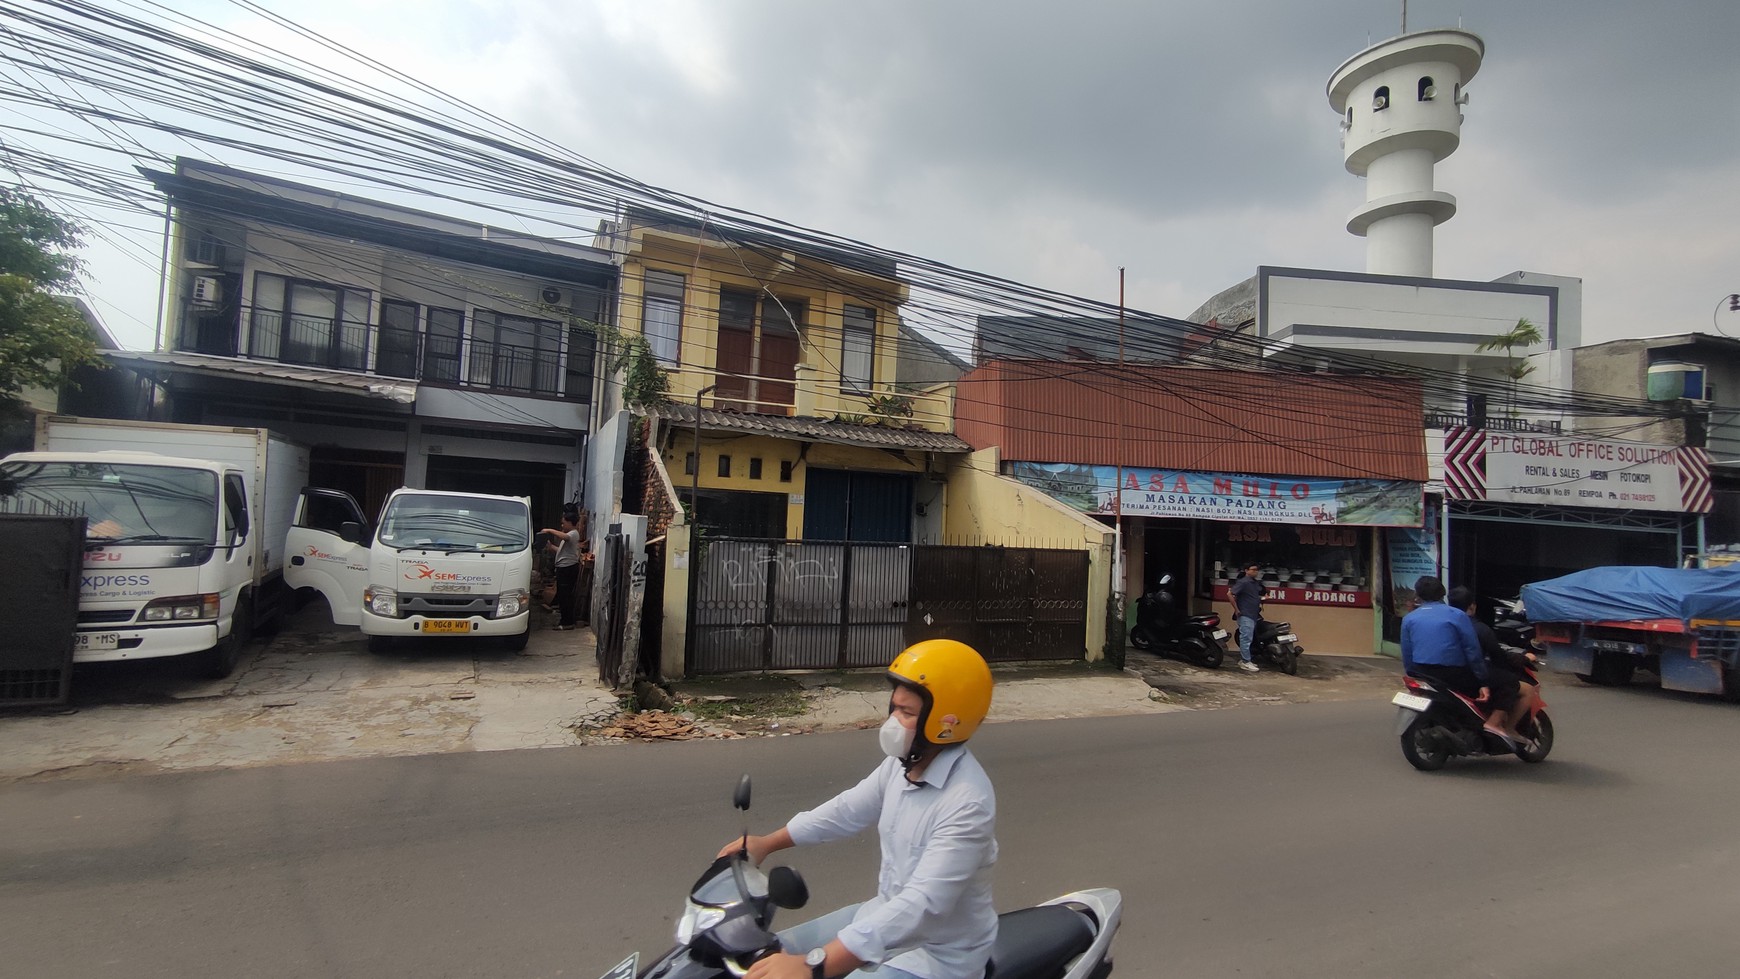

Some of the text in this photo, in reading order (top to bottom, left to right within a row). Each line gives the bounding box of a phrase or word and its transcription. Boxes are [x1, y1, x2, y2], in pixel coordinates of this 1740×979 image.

[1491, 436, 1676, 466] PT GLOBAL OFFICE SOLUTION
[1525, 465, 1651, 484] RENTAL & SALES MESIN FOTOKOPI
[1124, 472, 1191, 494] ASA
[1213, 477, 1311, 500] MULO
[1578, 489, 1603, 498] REMPOA
[1145, 493, 1288, 510] MASAKAN PADANG
[1258, 510, 1295, 518] BUNGKUS
[1228, 524, 1272, 543] ASA
[81, 573, 150, 590] xpress
[435, 573, 492, 582] SEMExpress
[129, 589, 156, 597] Logistic
[1305, 590, 1356, 603] PADANG
[101, 634, 116, 644] MS
